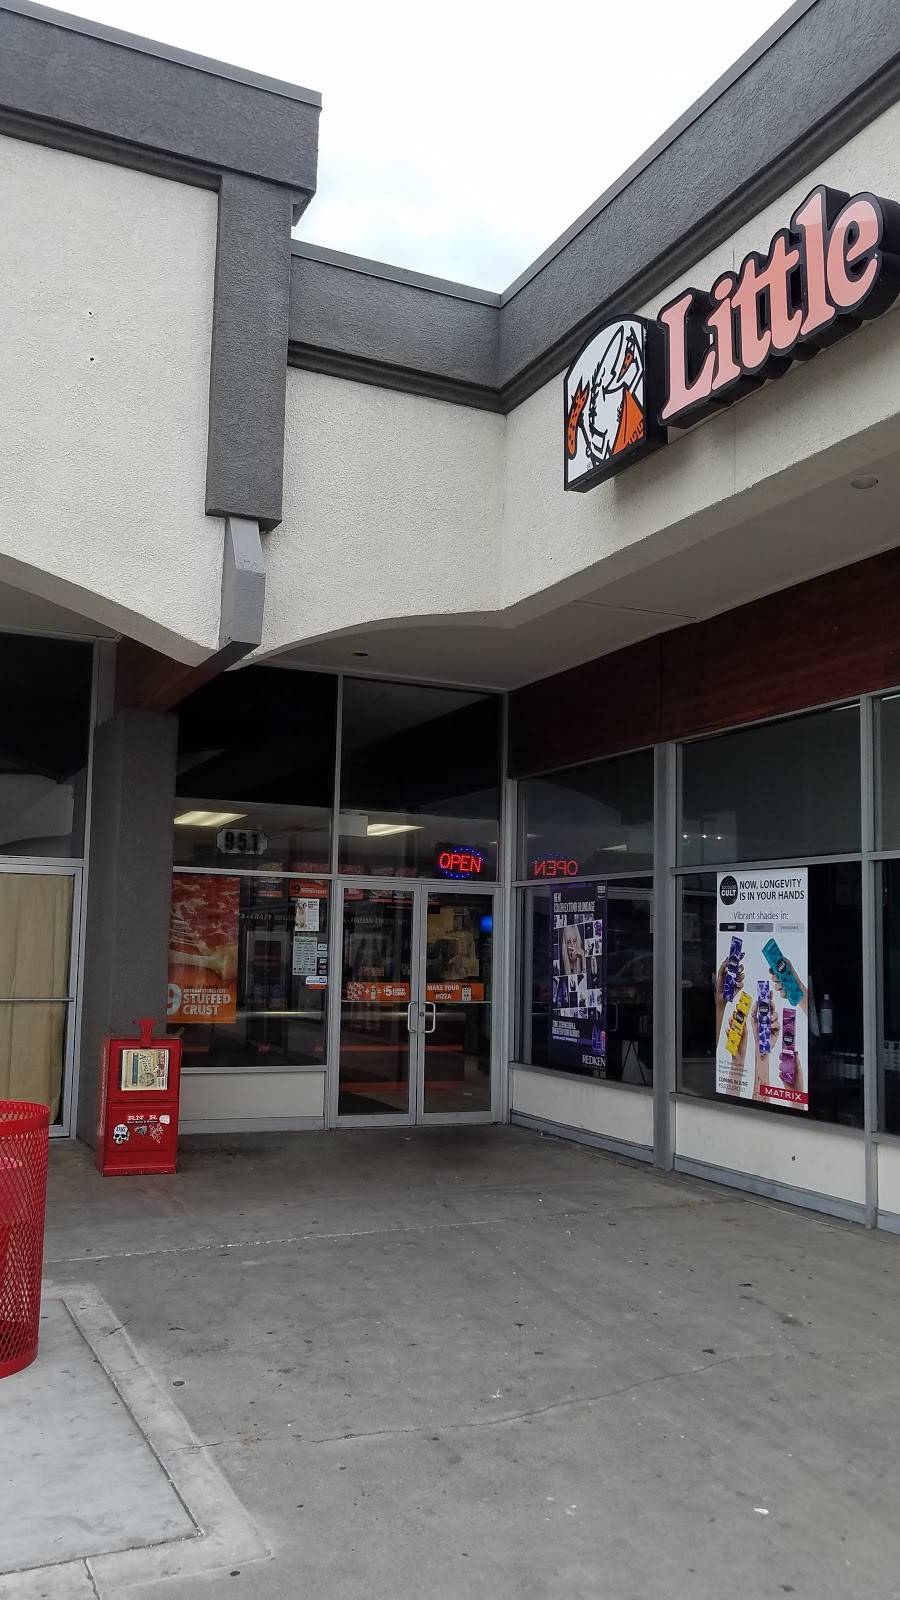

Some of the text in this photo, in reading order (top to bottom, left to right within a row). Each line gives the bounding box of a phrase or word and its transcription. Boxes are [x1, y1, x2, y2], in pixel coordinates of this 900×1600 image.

[657, 185, 883, 424] Little
[440, 853, 481, 873] OPEN
[740, 880, 759, 890] NOW,
[760, 878, 802, 889] LONGEVITY
[721, 889, 737, 897] CULT
[740, 890, 805, 900] IS IN YOUR HANDS
[733, 910, 788, 920] Vibrant shades in:
[443, 983, 460, 991] YOUR
[183, 993, 231, 1004] STUFFED
[183, 1004, 219, 1015] CRUST
[582, 1055, 606, 1067] REDKEN
[765, 1087, 802, 1101] MATRIX
